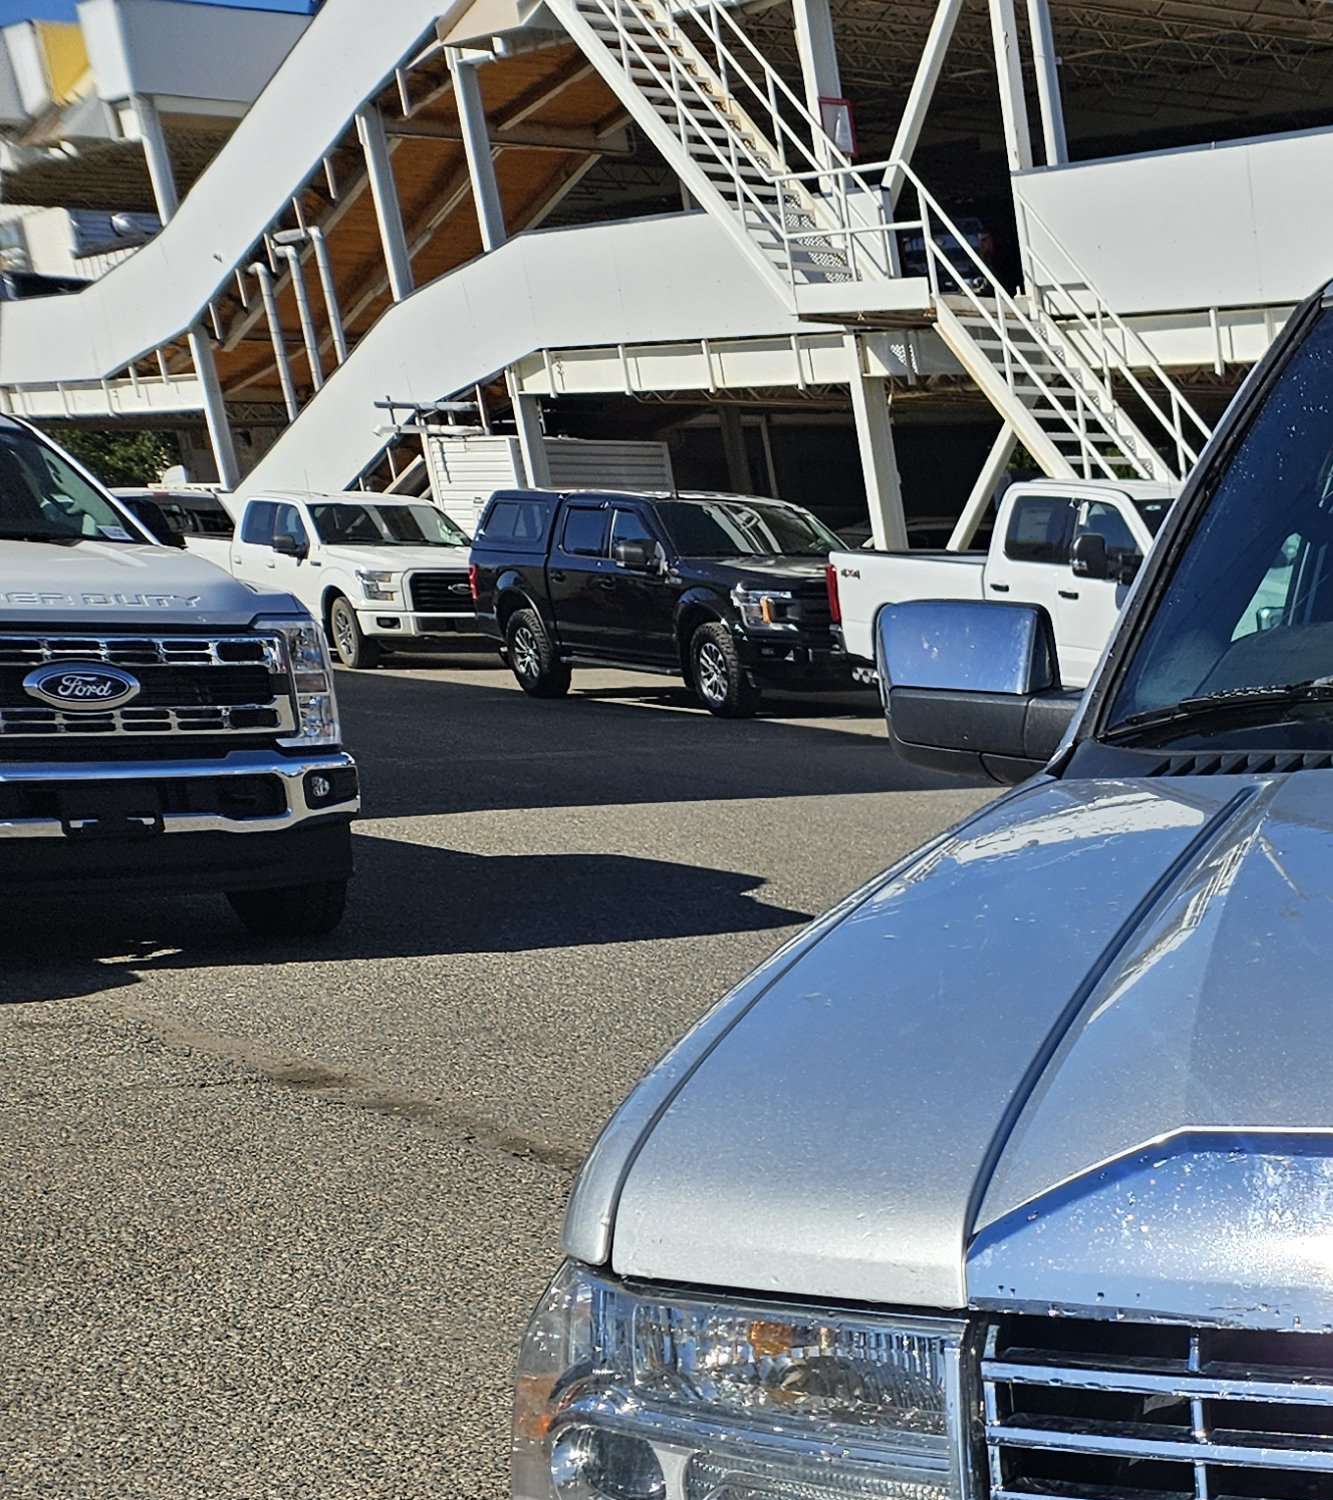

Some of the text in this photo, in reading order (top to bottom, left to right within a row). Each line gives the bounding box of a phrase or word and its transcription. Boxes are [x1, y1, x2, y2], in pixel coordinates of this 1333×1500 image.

[0, 592, 201, 608] ER DUTY
[58, 675, 112, 698] Ford
